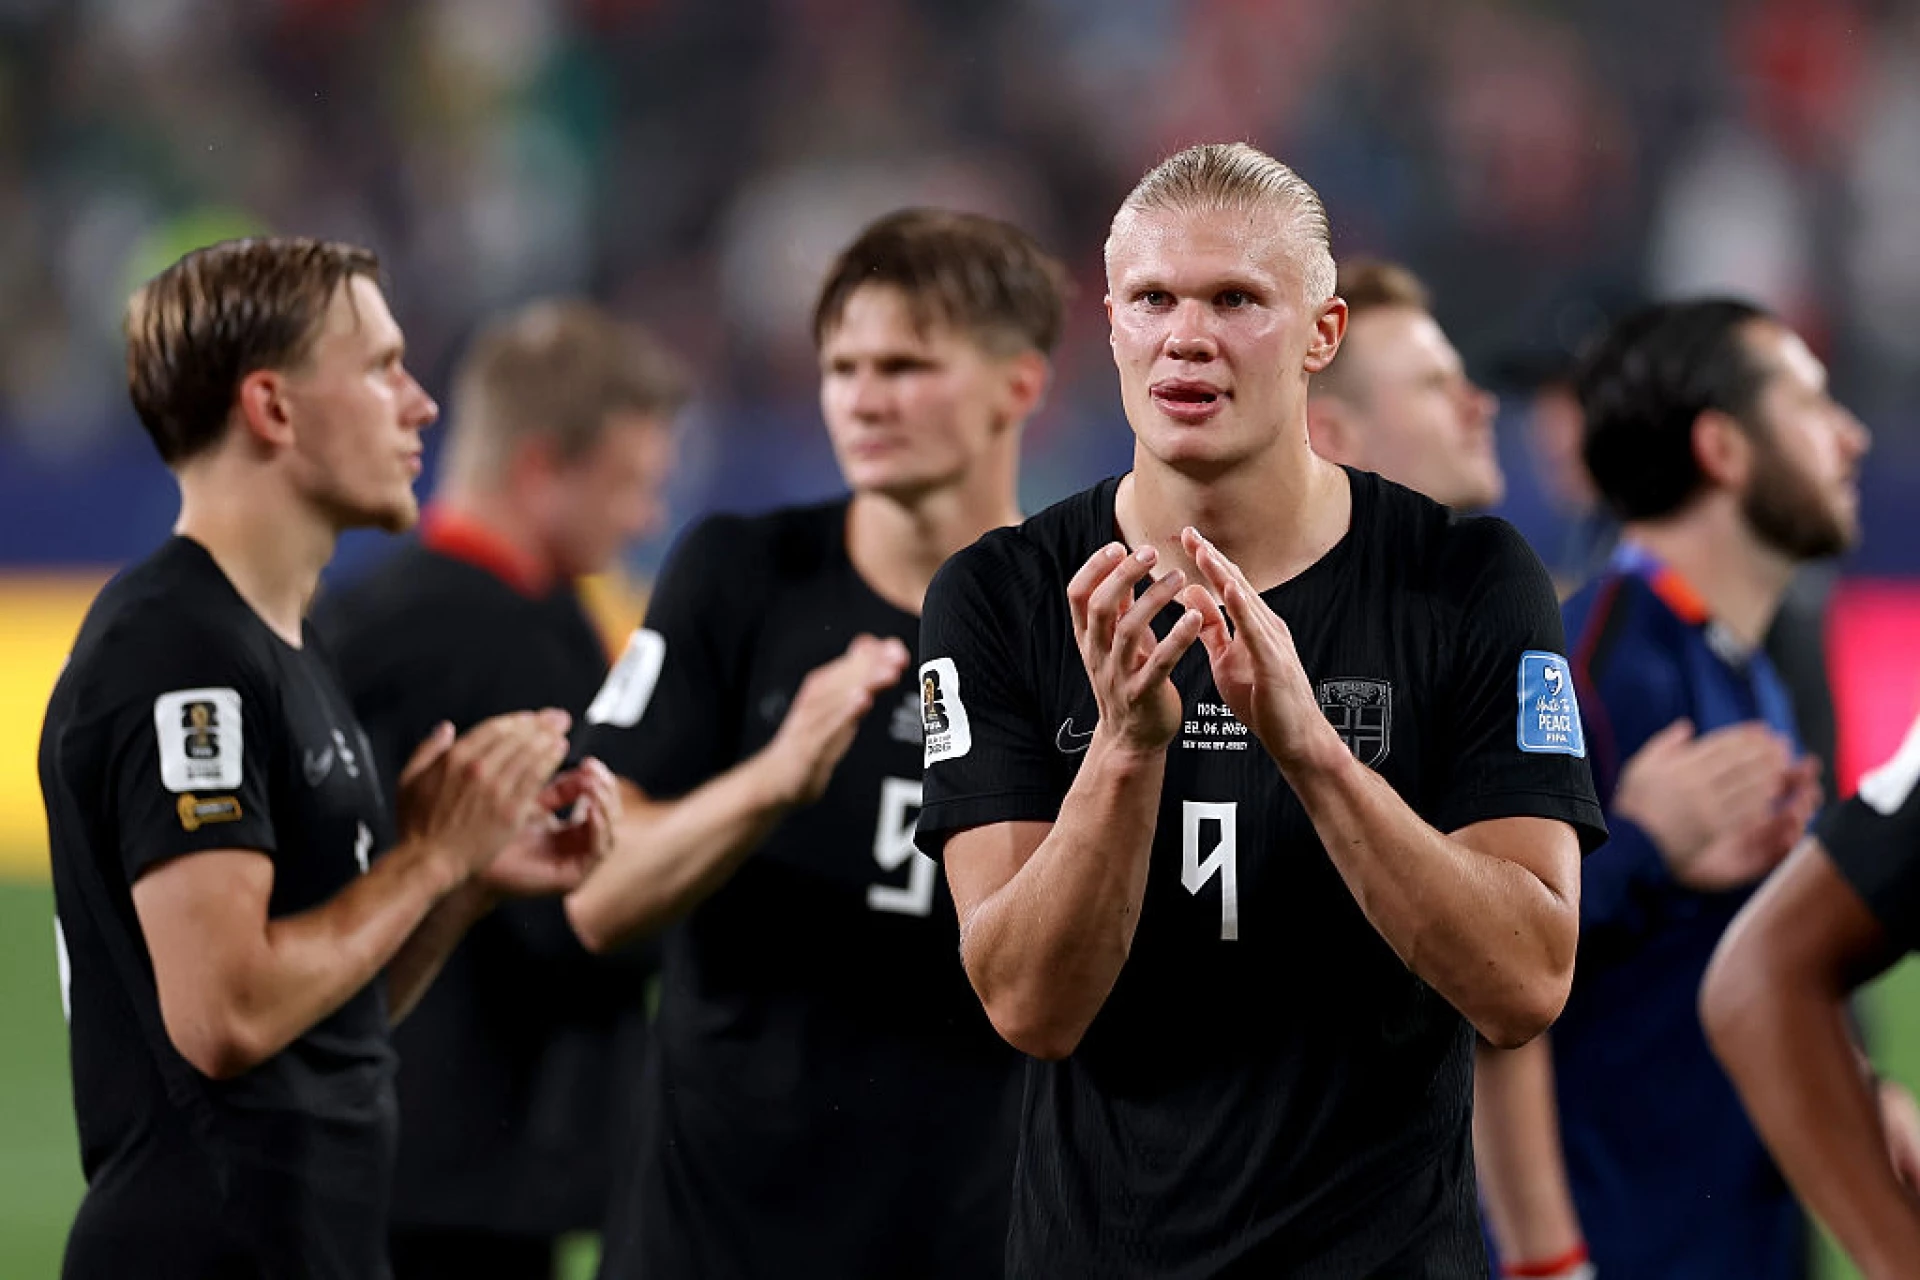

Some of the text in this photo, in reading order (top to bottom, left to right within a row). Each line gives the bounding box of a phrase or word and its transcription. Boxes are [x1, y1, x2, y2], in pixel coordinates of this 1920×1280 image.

[1546, 733, 1568, 742] FIFA
[866, 777, 938, 917] 5
[1181, 800, 1238, 941] 9
